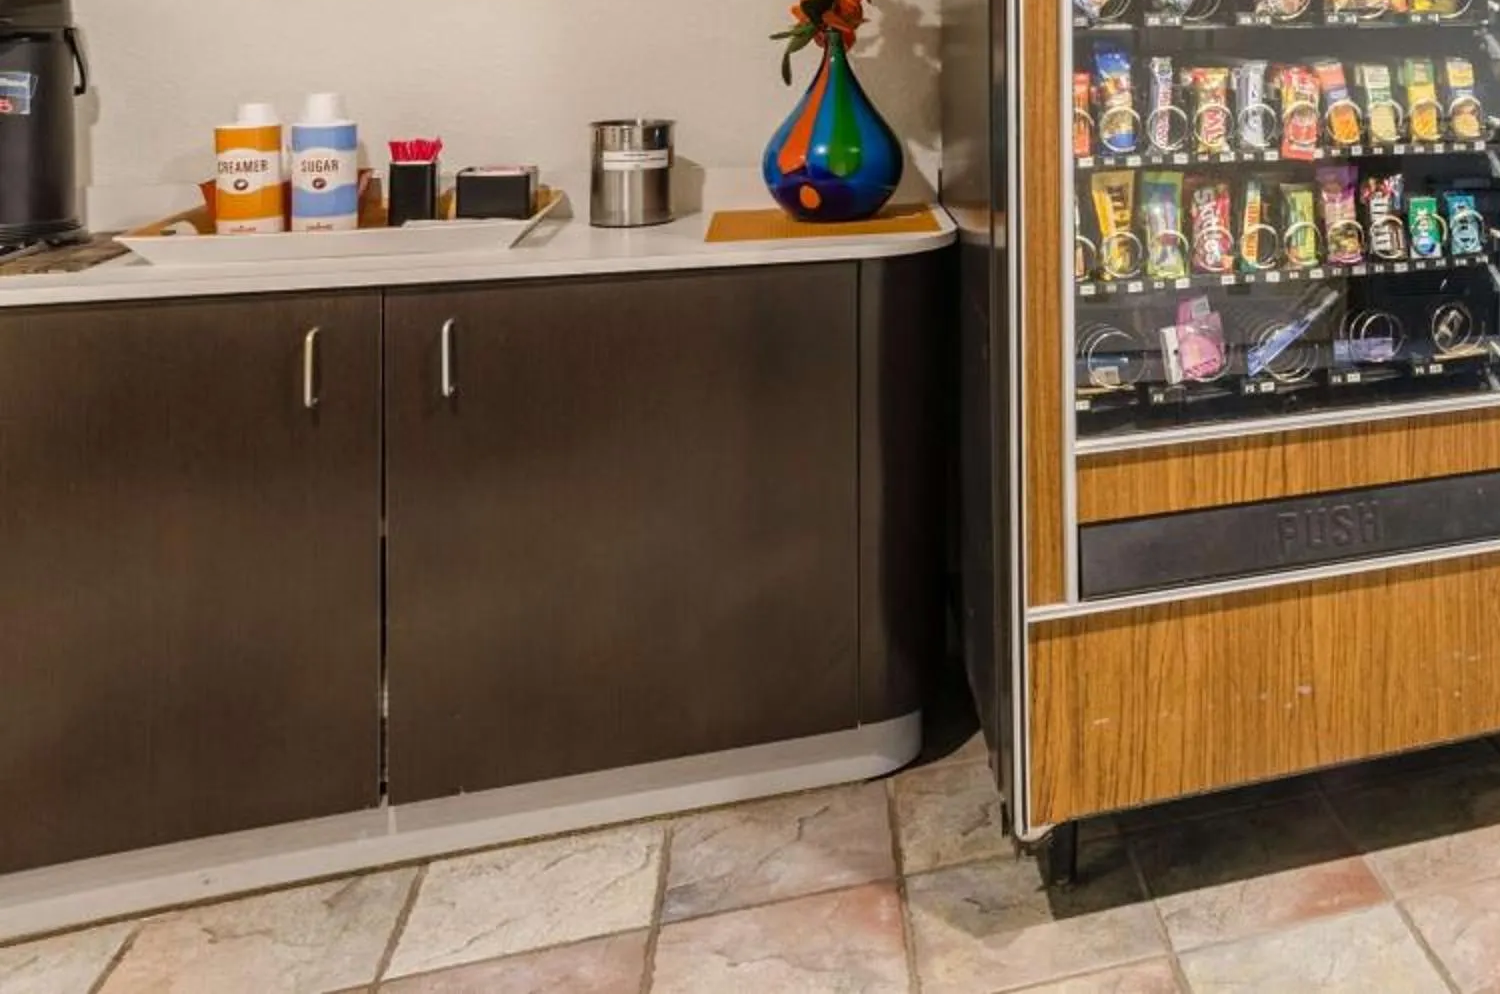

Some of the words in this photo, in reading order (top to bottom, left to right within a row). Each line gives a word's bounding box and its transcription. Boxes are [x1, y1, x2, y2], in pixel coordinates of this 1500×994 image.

[217, 159, 269, 174] CREAMER
[301, 159, 340, 173] SUGAR
[1277, 500, 1380, 556] PUSH
